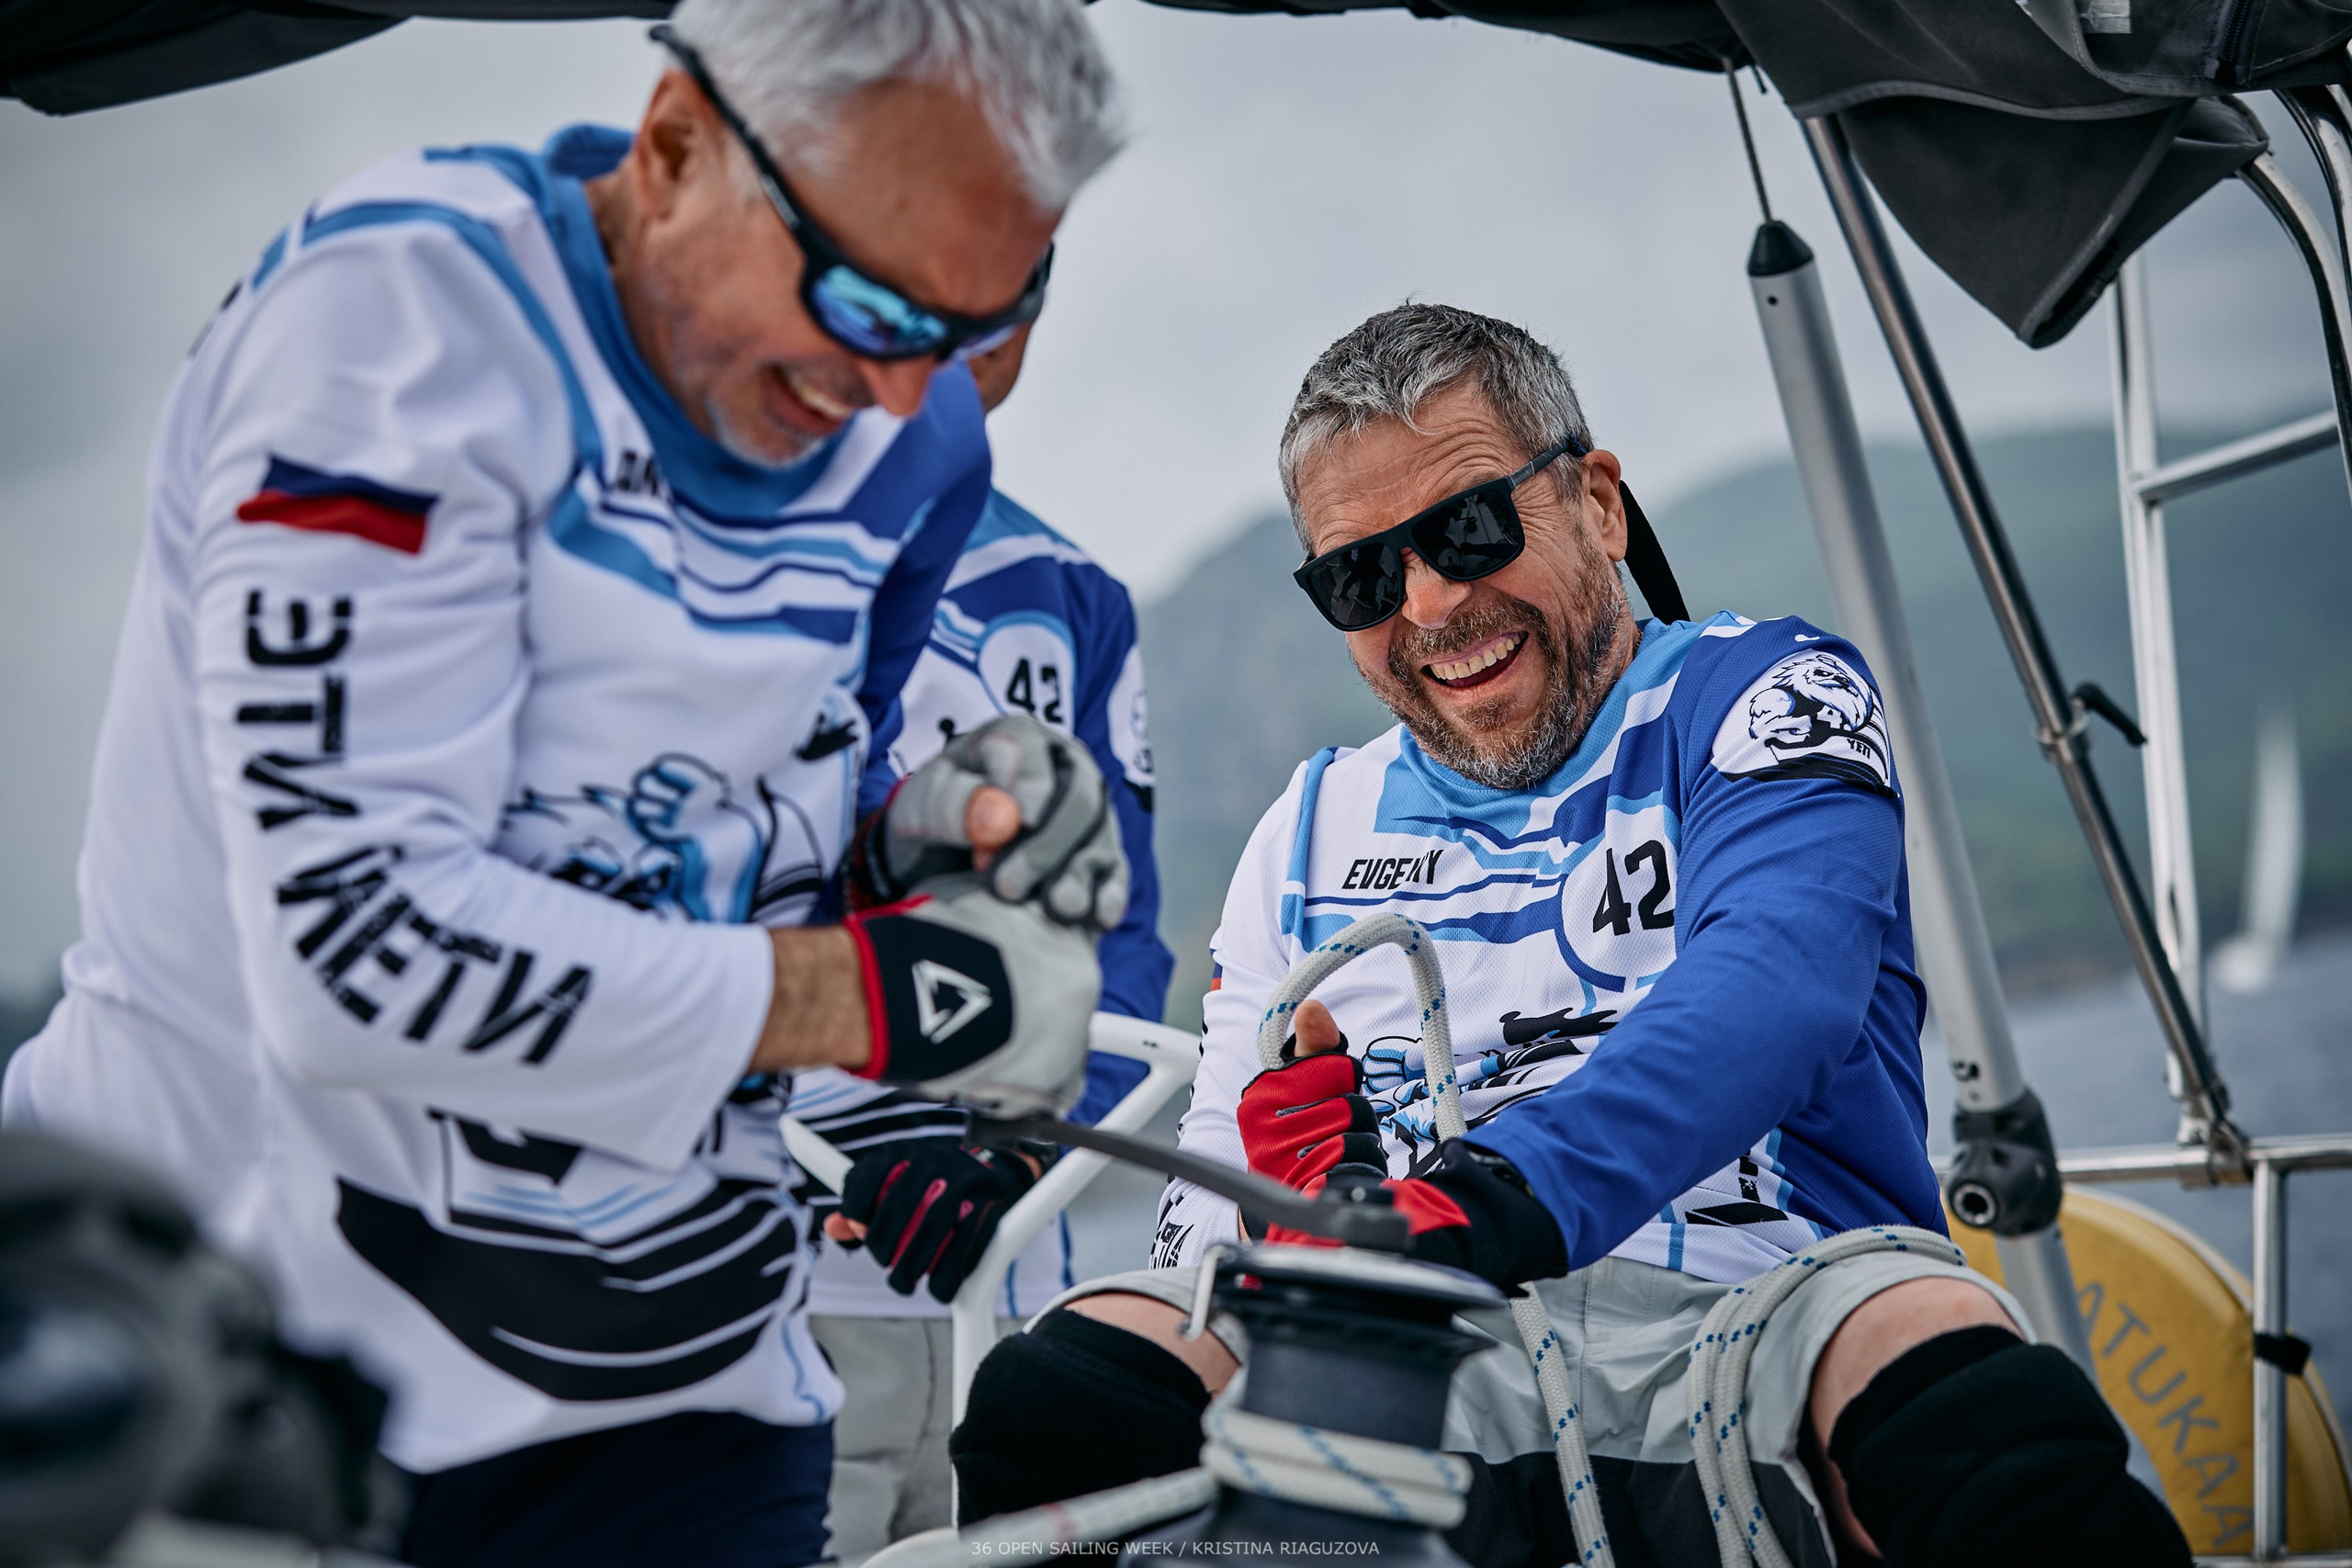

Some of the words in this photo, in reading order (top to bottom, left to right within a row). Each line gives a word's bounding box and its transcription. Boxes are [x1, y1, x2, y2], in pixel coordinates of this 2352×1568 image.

[1006, 658, 1063, 724] 42
[1816, 705, 1852, 731] 4
[1592, 840, 1675, 936] 42
